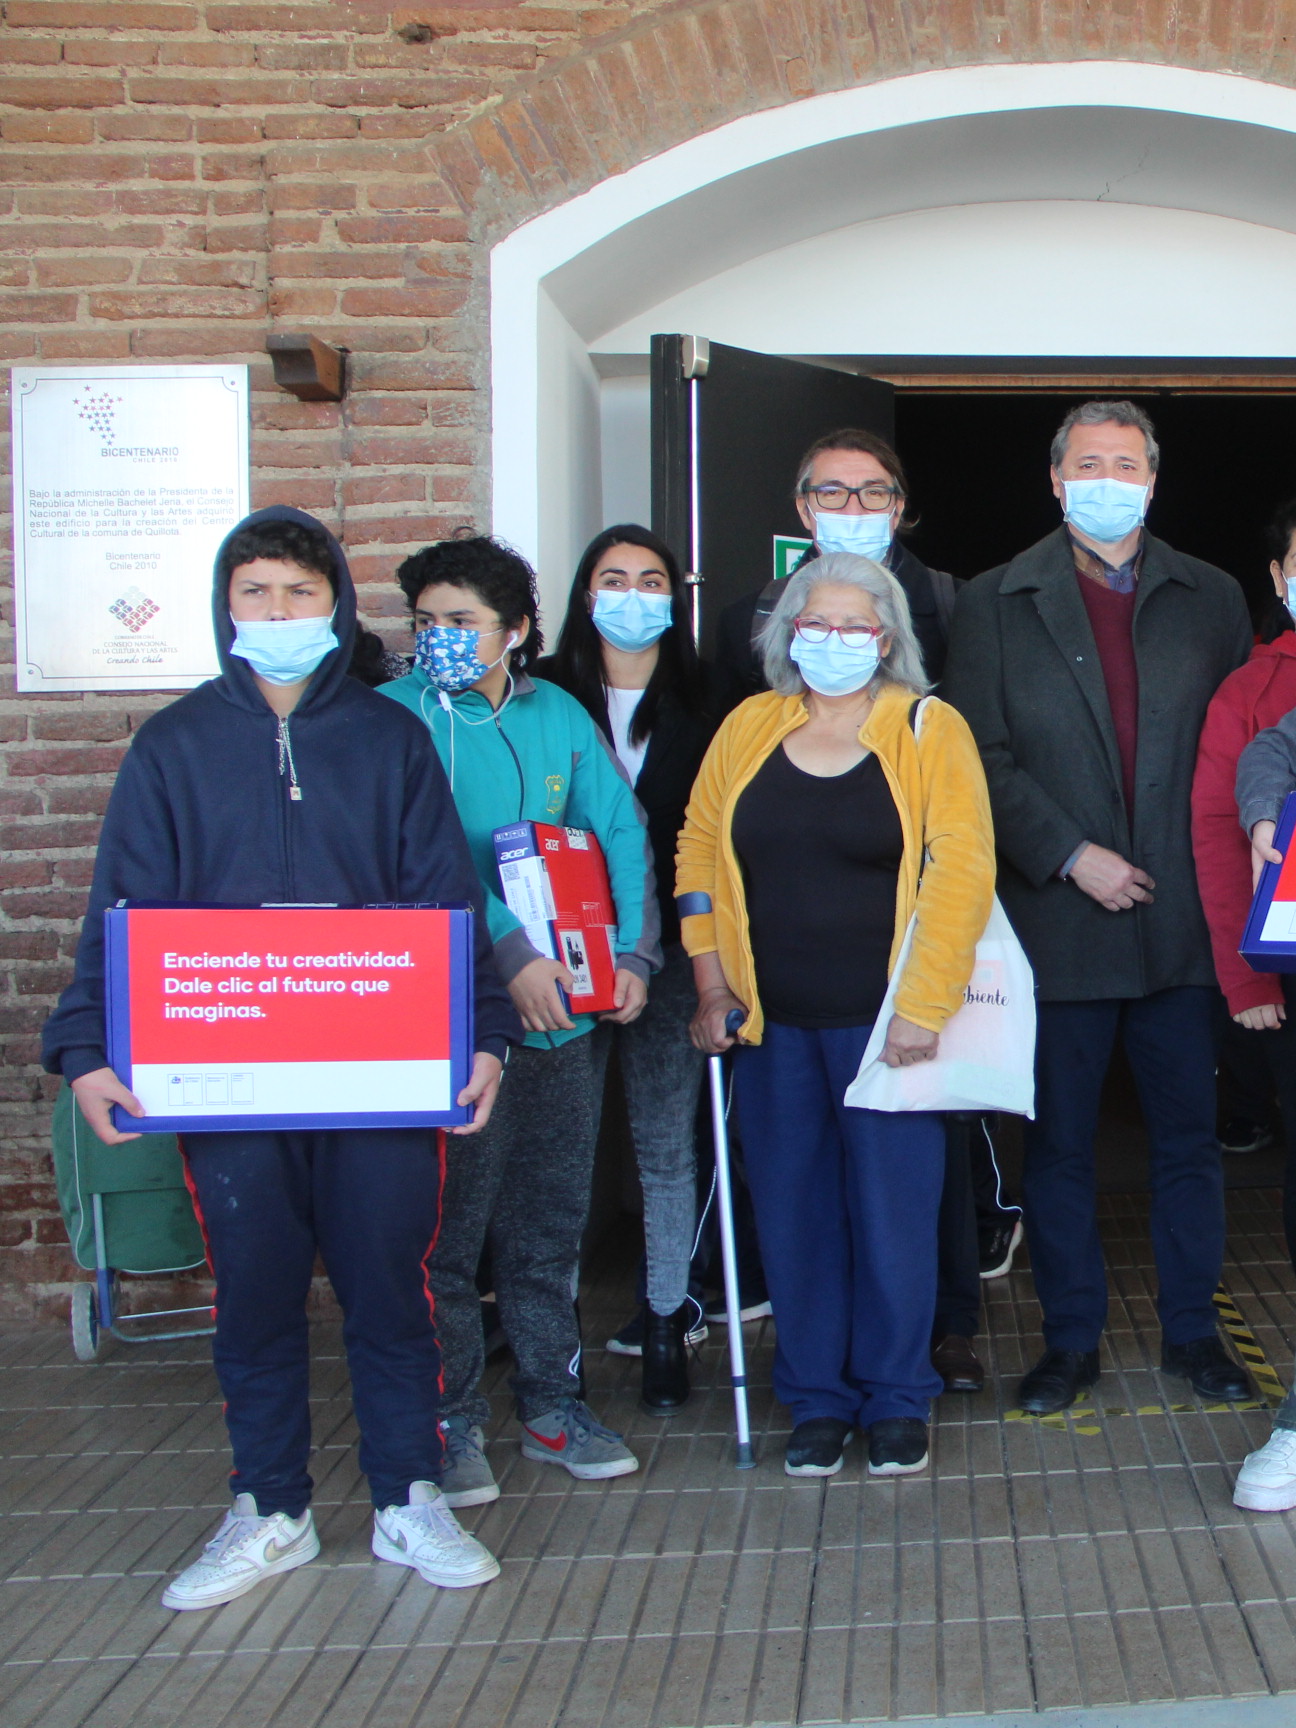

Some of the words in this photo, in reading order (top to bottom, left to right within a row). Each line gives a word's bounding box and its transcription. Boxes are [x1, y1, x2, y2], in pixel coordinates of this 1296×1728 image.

[101, 447, 179, 457] BICENTENARIO
[29, 489, 50, 499] Bajo
[53, 489, 61, 498] la
[64, 488, 130, 497] administración
[134, 488, 145, 497] de
[148, 488, 156, 496] la
[160, 487, 208, 496] Presidenta
[211, 487, 222, 495] de
[226, 487, 234, 495] la
[29, 498, 74, 509] República
[77, 498, 114, 507] Michelle
[117, 497, 156, 507] Bachelet
[186, 497, 195, 505] el
[197, 496, 234, 507] Consejo
[29, 508, 71, 518] Nacional
[75, 508, 87, 517] de
[90, 508, 99, 517] la
[103, 508, 138, 517] Cultura
[141, 509, 147, 519] y
[151, 507, 164, 516] las
[168, 507, 192, 516] Artes
[196, 506, 234, 517] adquirió
[29, 519, 50, 528] este
[55, 518, 91, 528] edificio
[95, 519, 117, 530] para
[122, 518, 131, 527] la
[135, 517, 177, 527] creación
[182, 517, 196, 526] del
[201, 516, 234, 525] Centro
[29, 528, 65, 538] Cultural
[67, 528, 79, 537] de
[82, 528, 90, 537] la
[92, 529, 129, 537] comuna
[131, 528, 142, 537] de
[145, 527, 182, 536] Quillota.
[105, 552, 161, 560] Bicentenario
[109, 561, 133, 570] Chile
[135, 561, 157, 570] 2010
[106, 654, 140, 664] Creando
[141, 653, 163, 664] Chile
[544, 838, 560, 851] acer
[500, 846, 529, 861] acer
[164, 951, 261, 968] Enciende
[265, 952, 288, 968] tu
[292, 951, 416, 968] creatividad.
[164, 976, 212, 994] Dale
[217, 976, 253, 993] clic
[258, 977, 277, 993] al
[282, 976, 346, 993] futuro
[350, 979, 390, 996] que
[963, 985, 1010, 1007] biente
[164, 1002, 267, 1022] imaginas.
